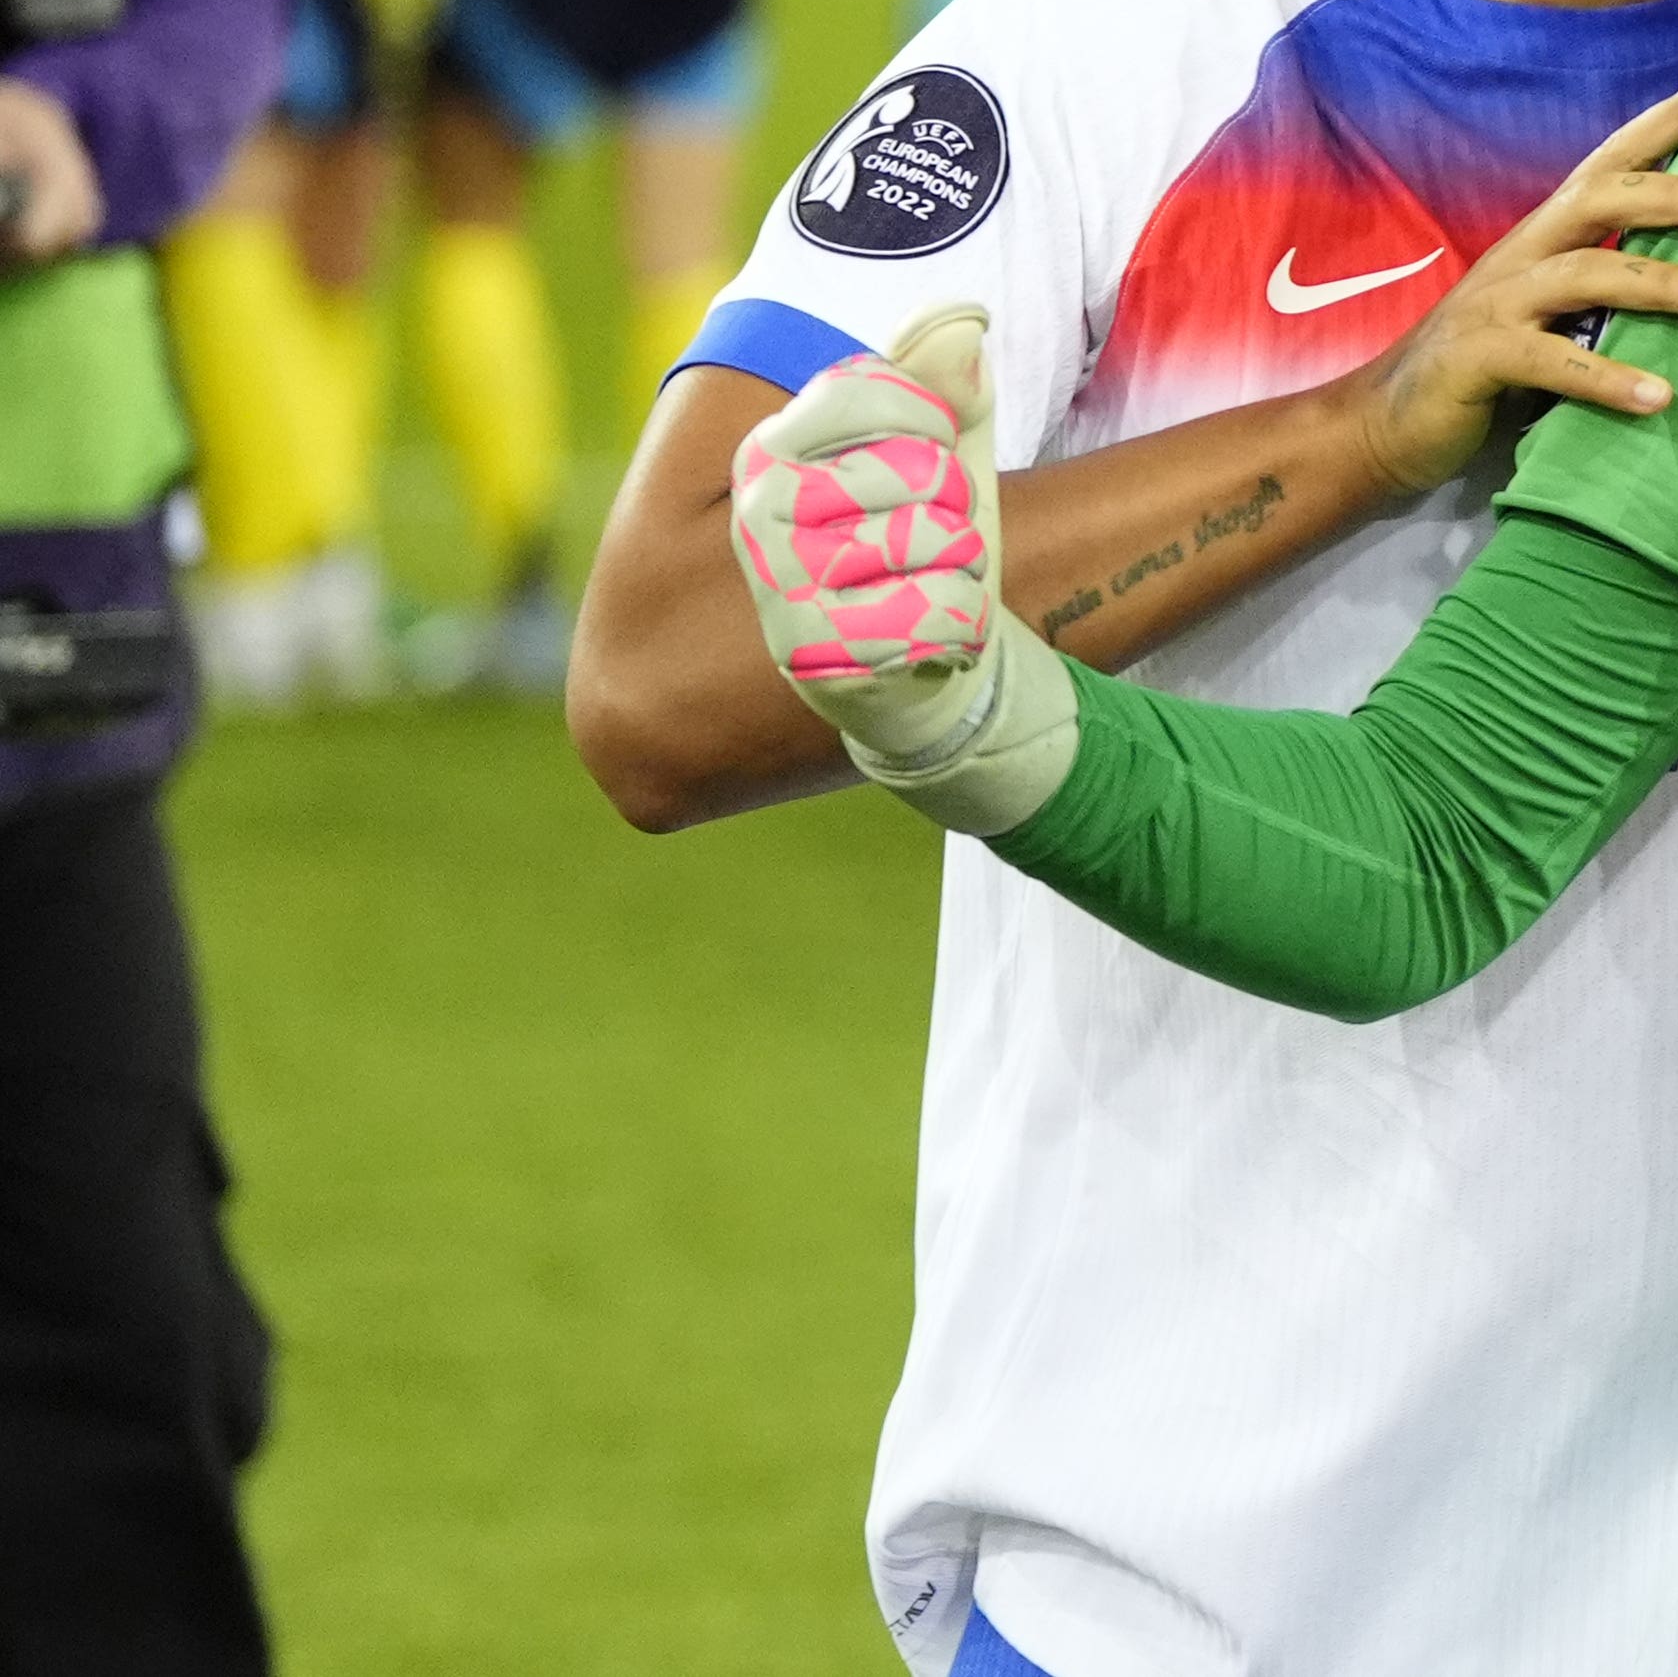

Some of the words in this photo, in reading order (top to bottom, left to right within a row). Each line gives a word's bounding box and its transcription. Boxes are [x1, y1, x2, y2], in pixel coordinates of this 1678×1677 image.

[913, 124, 967, 155] UEFA
[862, 154, 973, 210] CHAMPIONS
[877, 138, 979, 190] EUROPEAN
[867, 179, 936, 220] 2022
